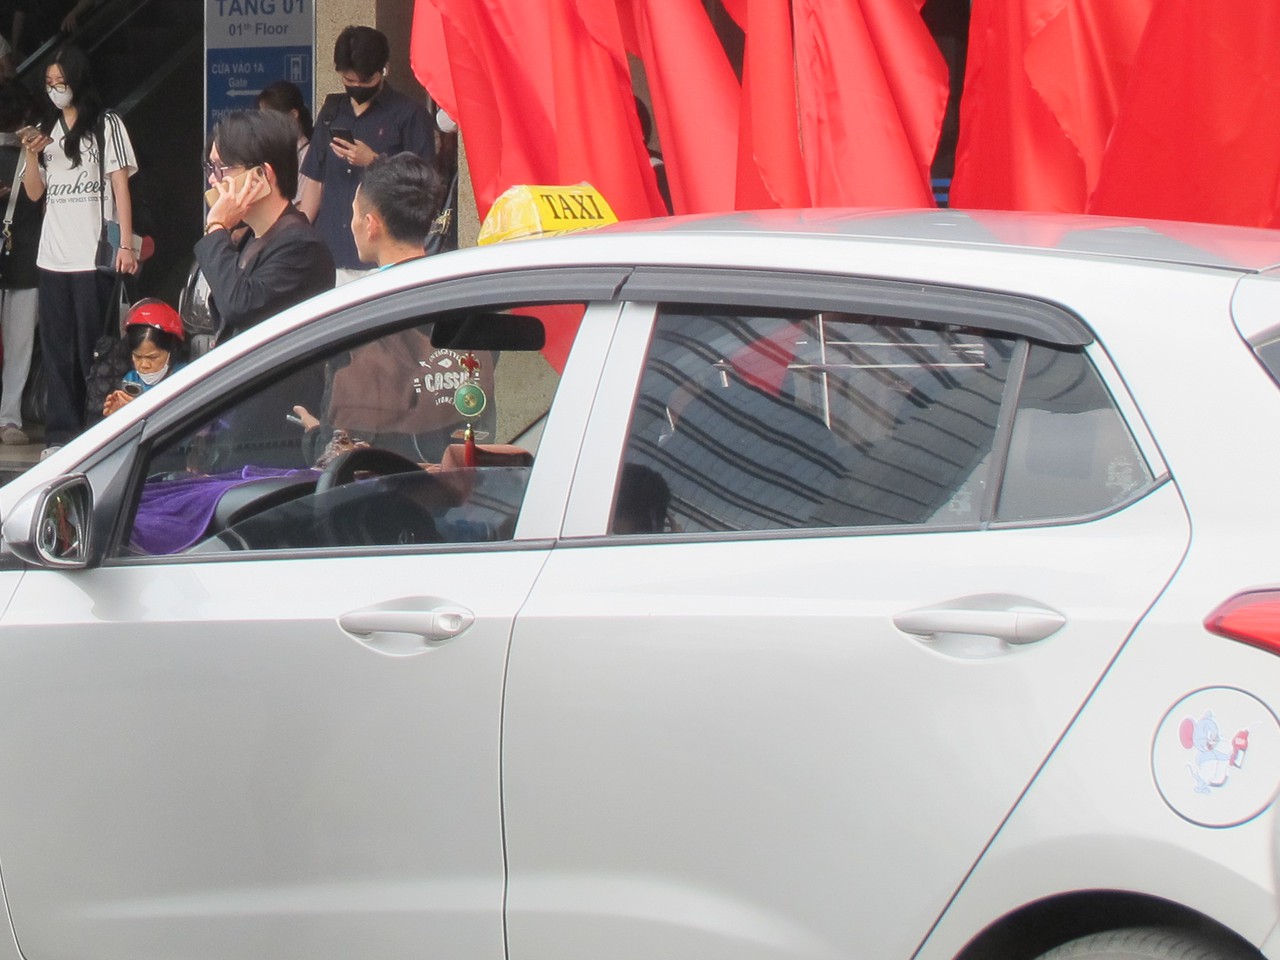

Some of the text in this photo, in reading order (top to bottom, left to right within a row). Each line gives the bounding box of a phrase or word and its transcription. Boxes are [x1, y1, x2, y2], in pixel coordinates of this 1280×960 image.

[255, 21, 288, 35] Floor
[228, 77, 248, 88] Gate
[540, 193, 605, 220] TAXI
